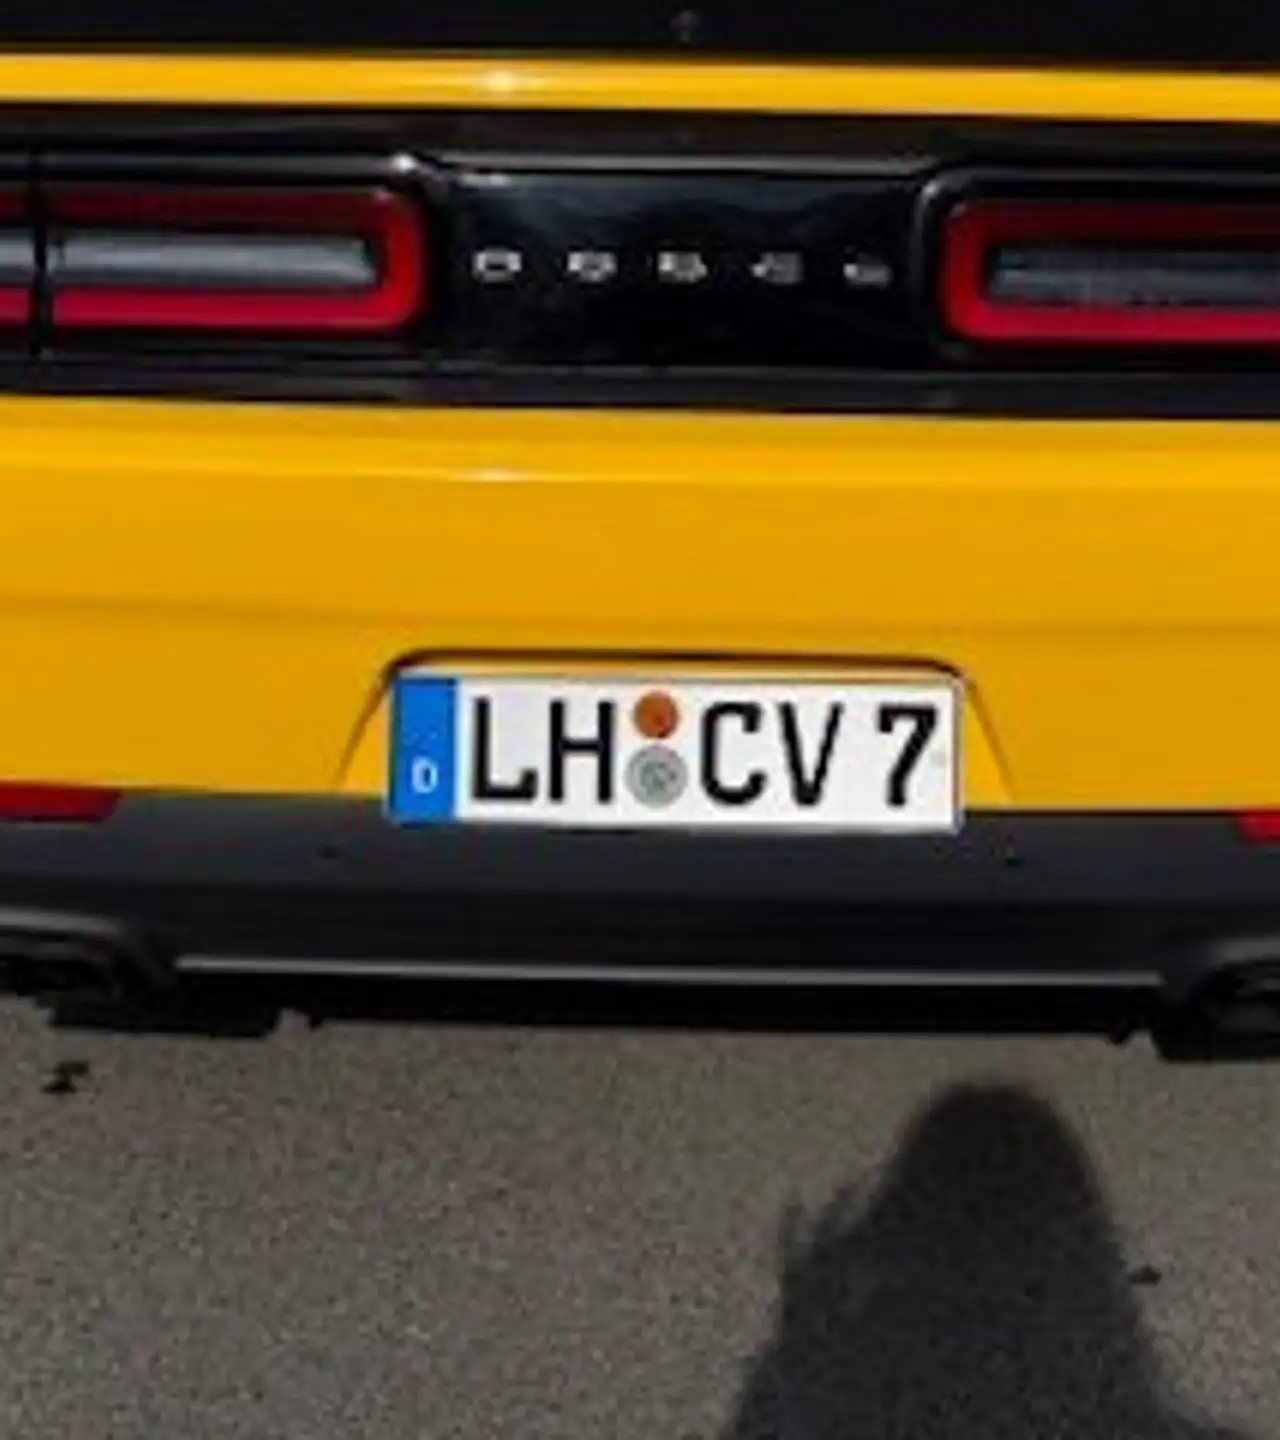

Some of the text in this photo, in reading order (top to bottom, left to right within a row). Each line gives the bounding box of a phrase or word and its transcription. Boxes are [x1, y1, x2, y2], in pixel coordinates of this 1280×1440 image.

[471, 696, 939, 807] LH CV 7
